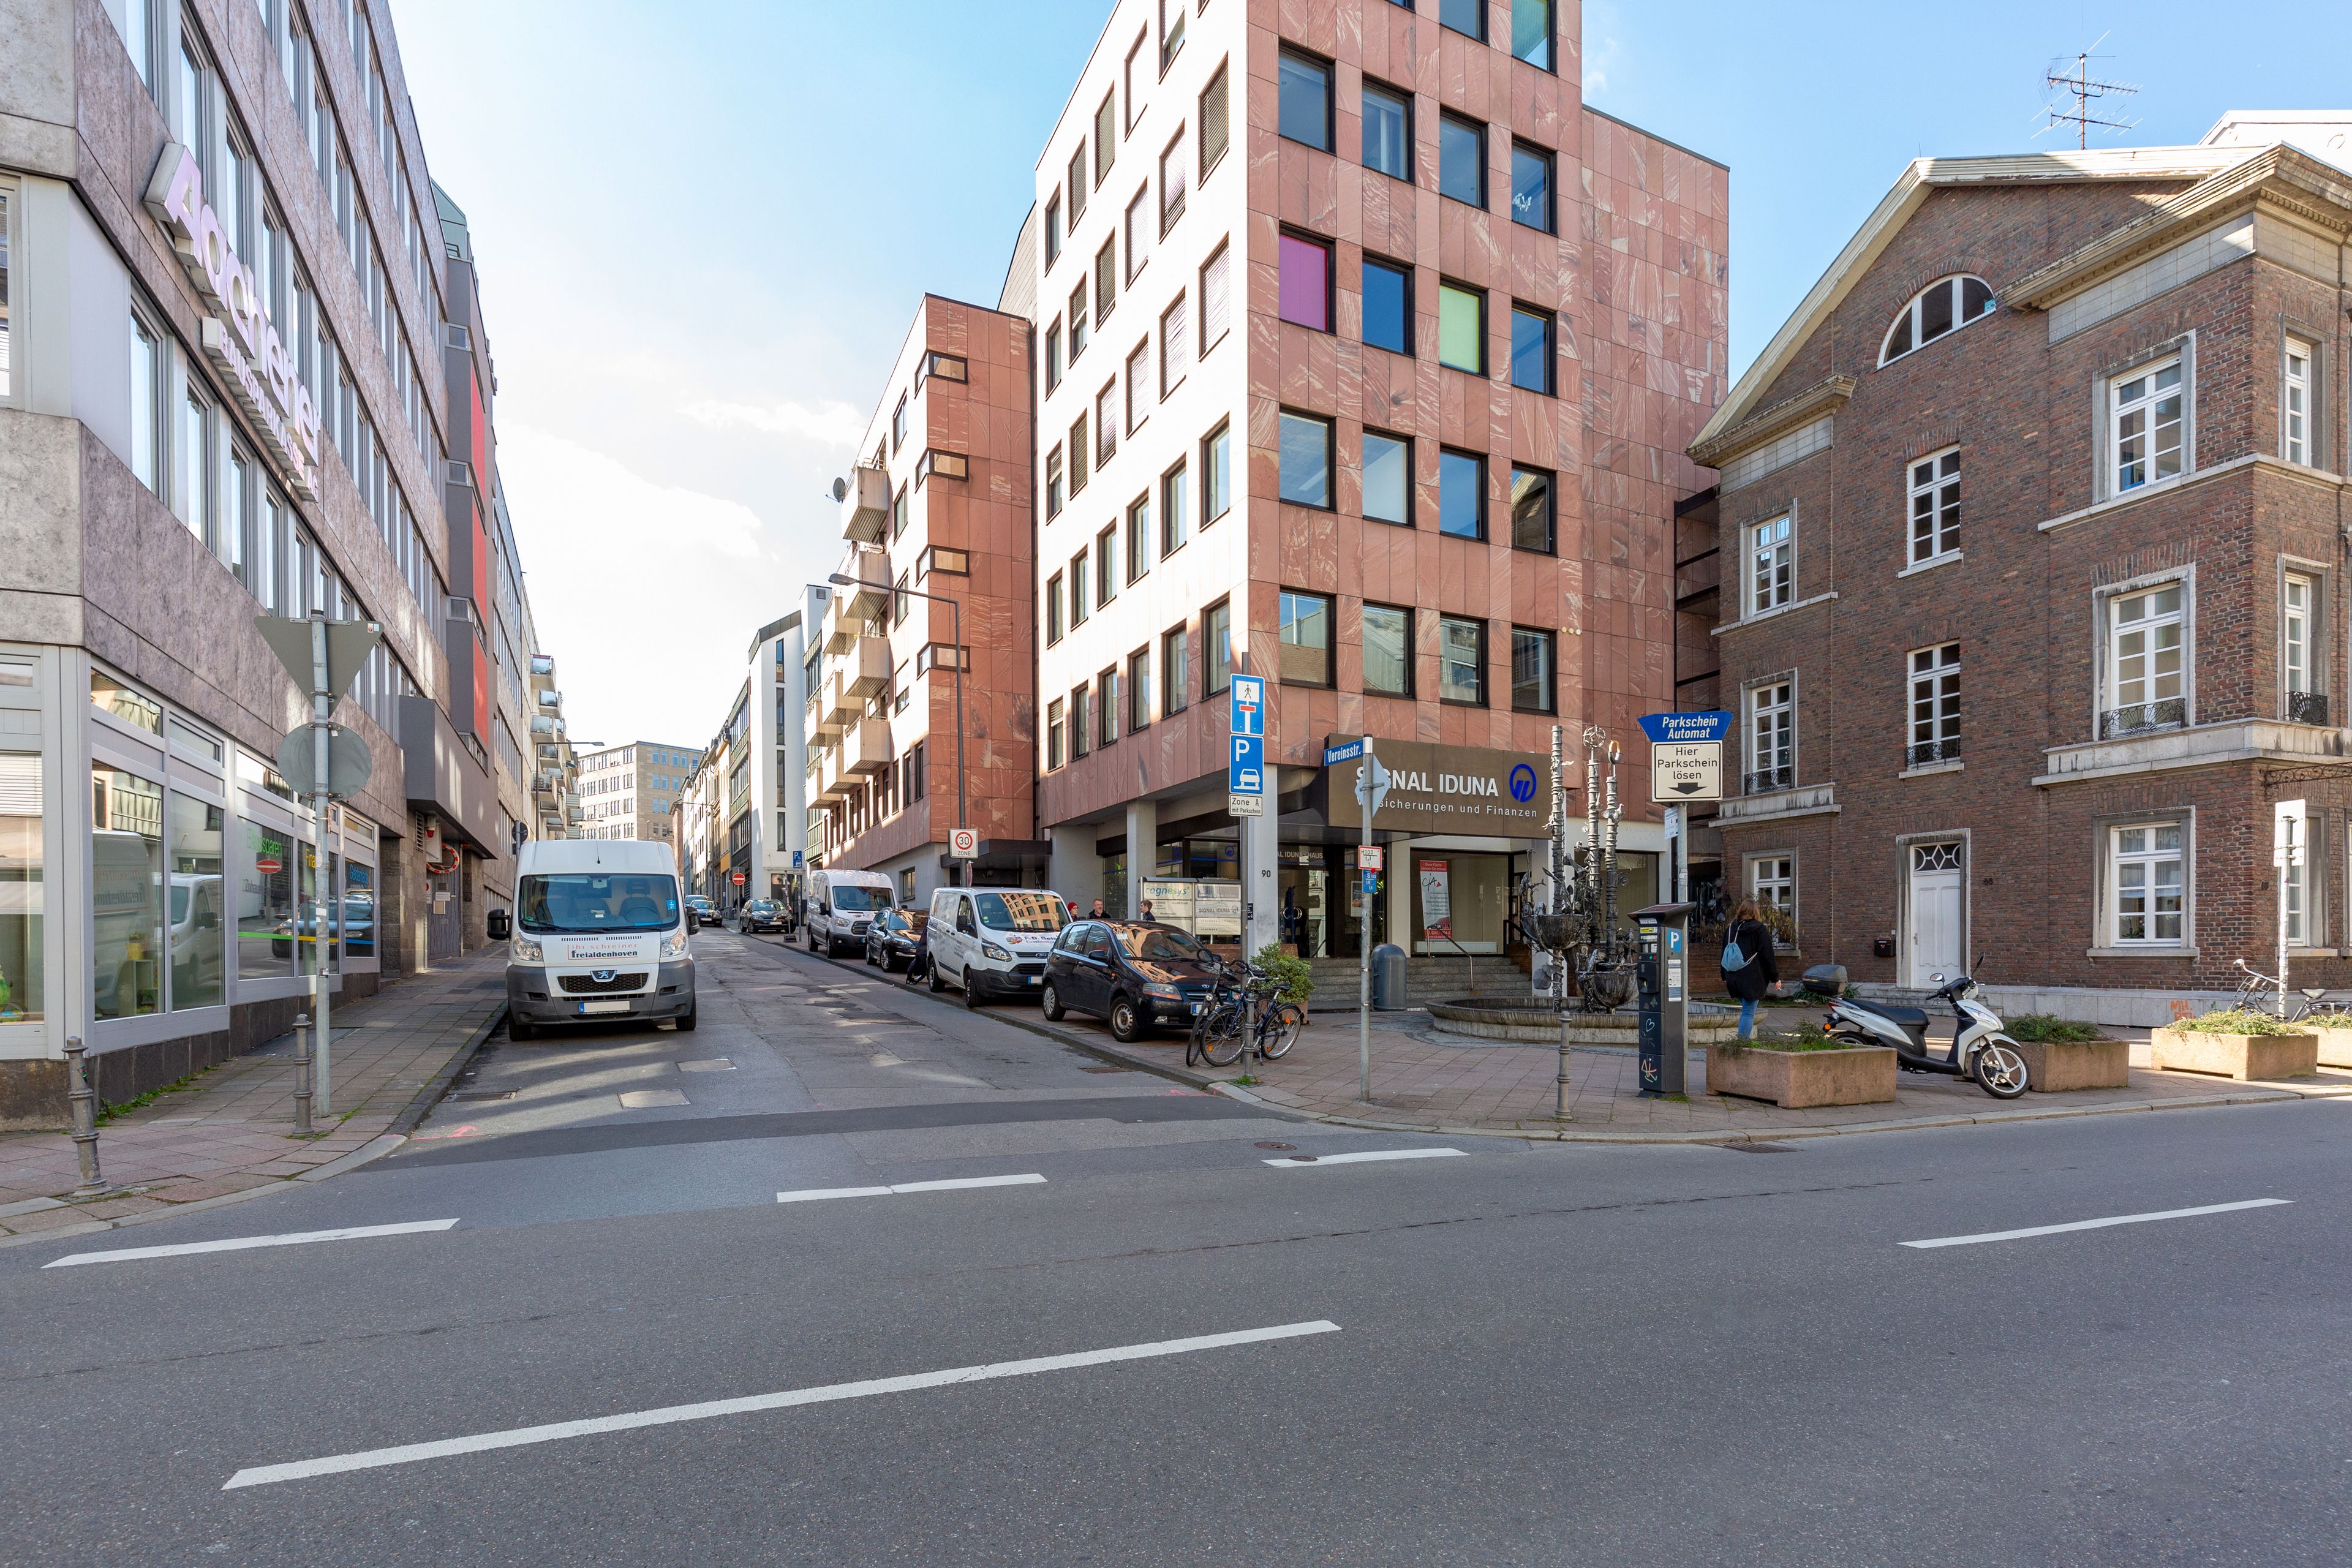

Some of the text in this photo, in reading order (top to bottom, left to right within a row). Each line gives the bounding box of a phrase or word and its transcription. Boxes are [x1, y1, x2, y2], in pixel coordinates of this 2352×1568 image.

[163, 145, 321, 467] Aachener
[307, 466, 318, 503] AG
[1662, 715, 1718, 728] Parkschein
[1667, 728, 1710, 739] Automat
[1235, 739, 1250, 761] P
[1328, 744, 1361, 763] Vereinsstr.
[1676, 747, 1698, 756] Hier
[1657, 758, 1717, 768] Parkschein
[1673, 771, 1702, 779] lösen
[1439, 773, 1499, 796] IDUNA
[1460, 803, 1480, 814] und
[1487, 805, 1537, 817] Finanzen
[959, 837, 970, 845] 30
[1146, 888, 1186, 897] cognesys
[1670, 932, 1679, 948] P
